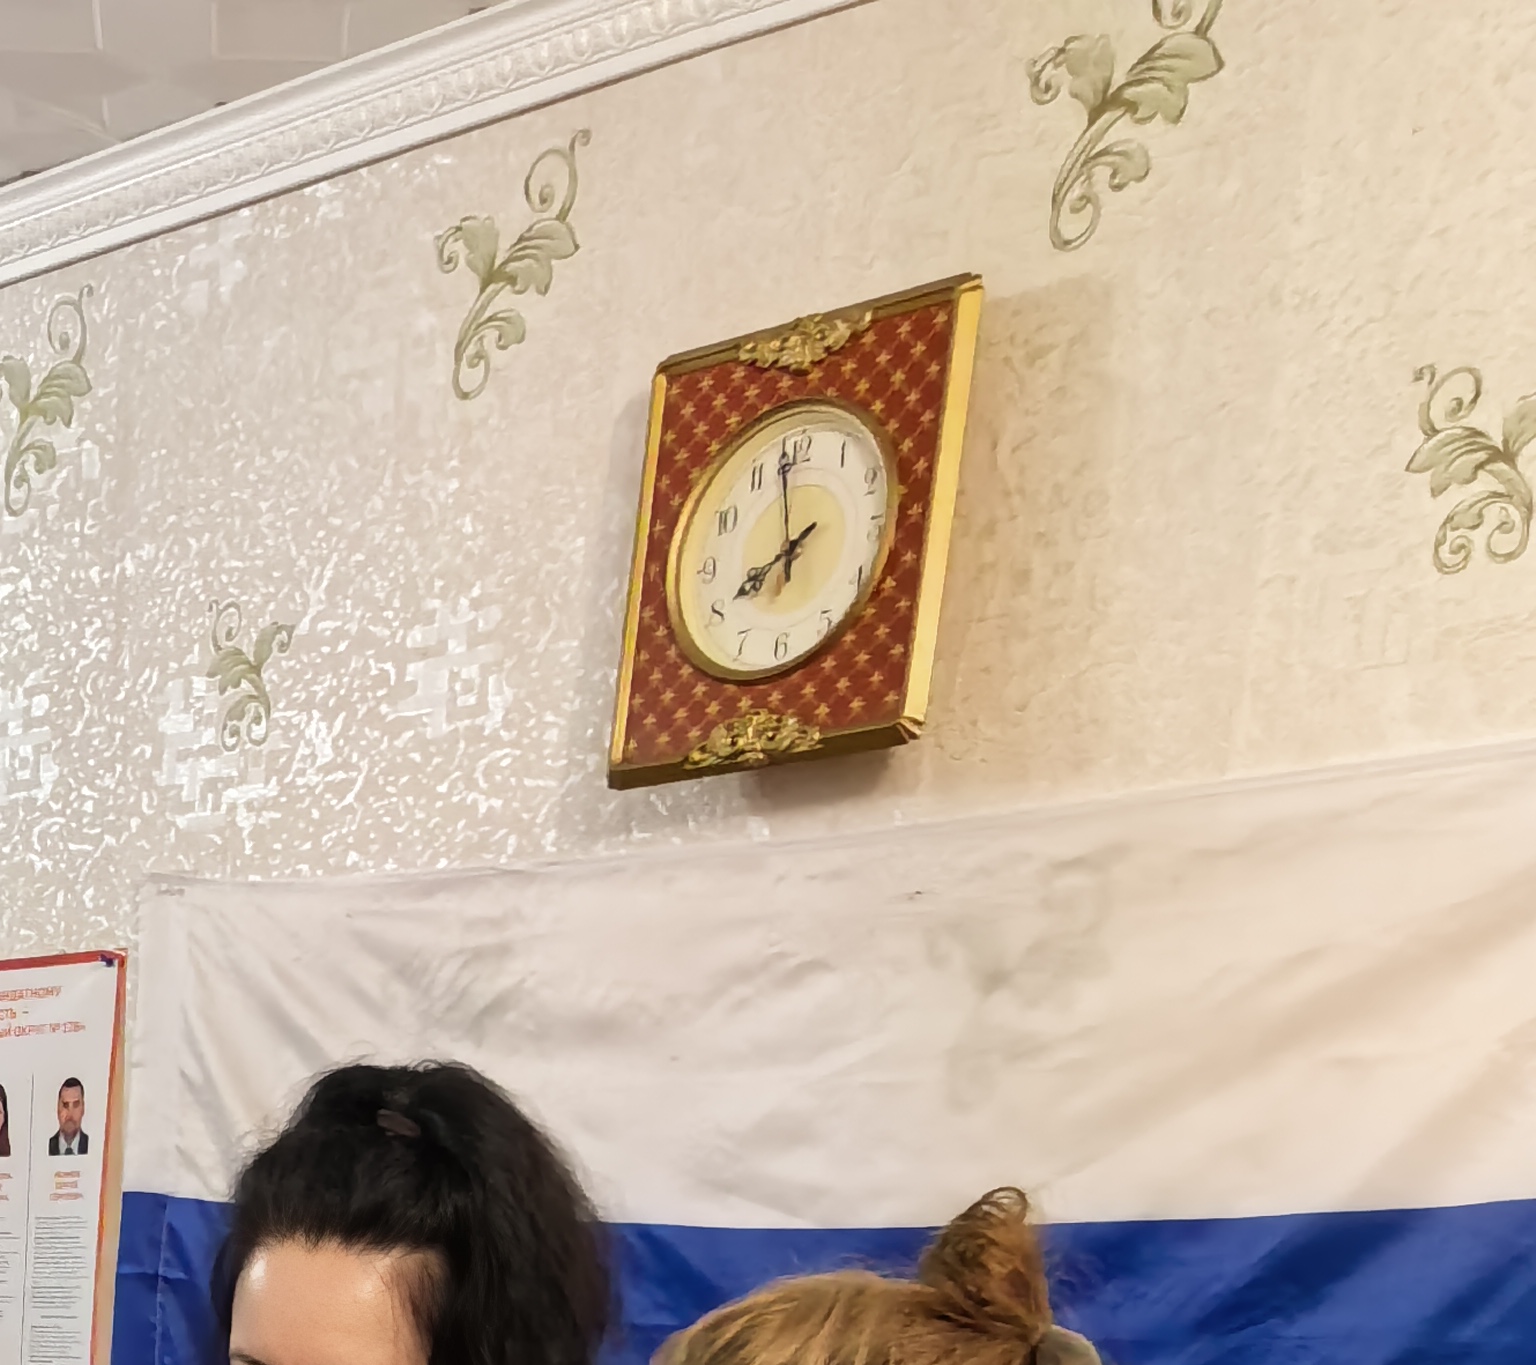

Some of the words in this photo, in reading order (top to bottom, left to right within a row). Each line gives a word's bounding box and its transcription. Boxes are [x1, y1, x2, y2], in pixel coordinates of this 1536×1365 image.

[749, 459, 764, 494] 11
[863, 466, 878, 497] 2
[715, 505, 739, 537] 10
[696, 556, 717, 585] 9
[704, 599, 726, 629] 8
[816, 608, 833, 637] 5
[732, 628, 752, 662] 7
[773, 631, 790, 661] 6
